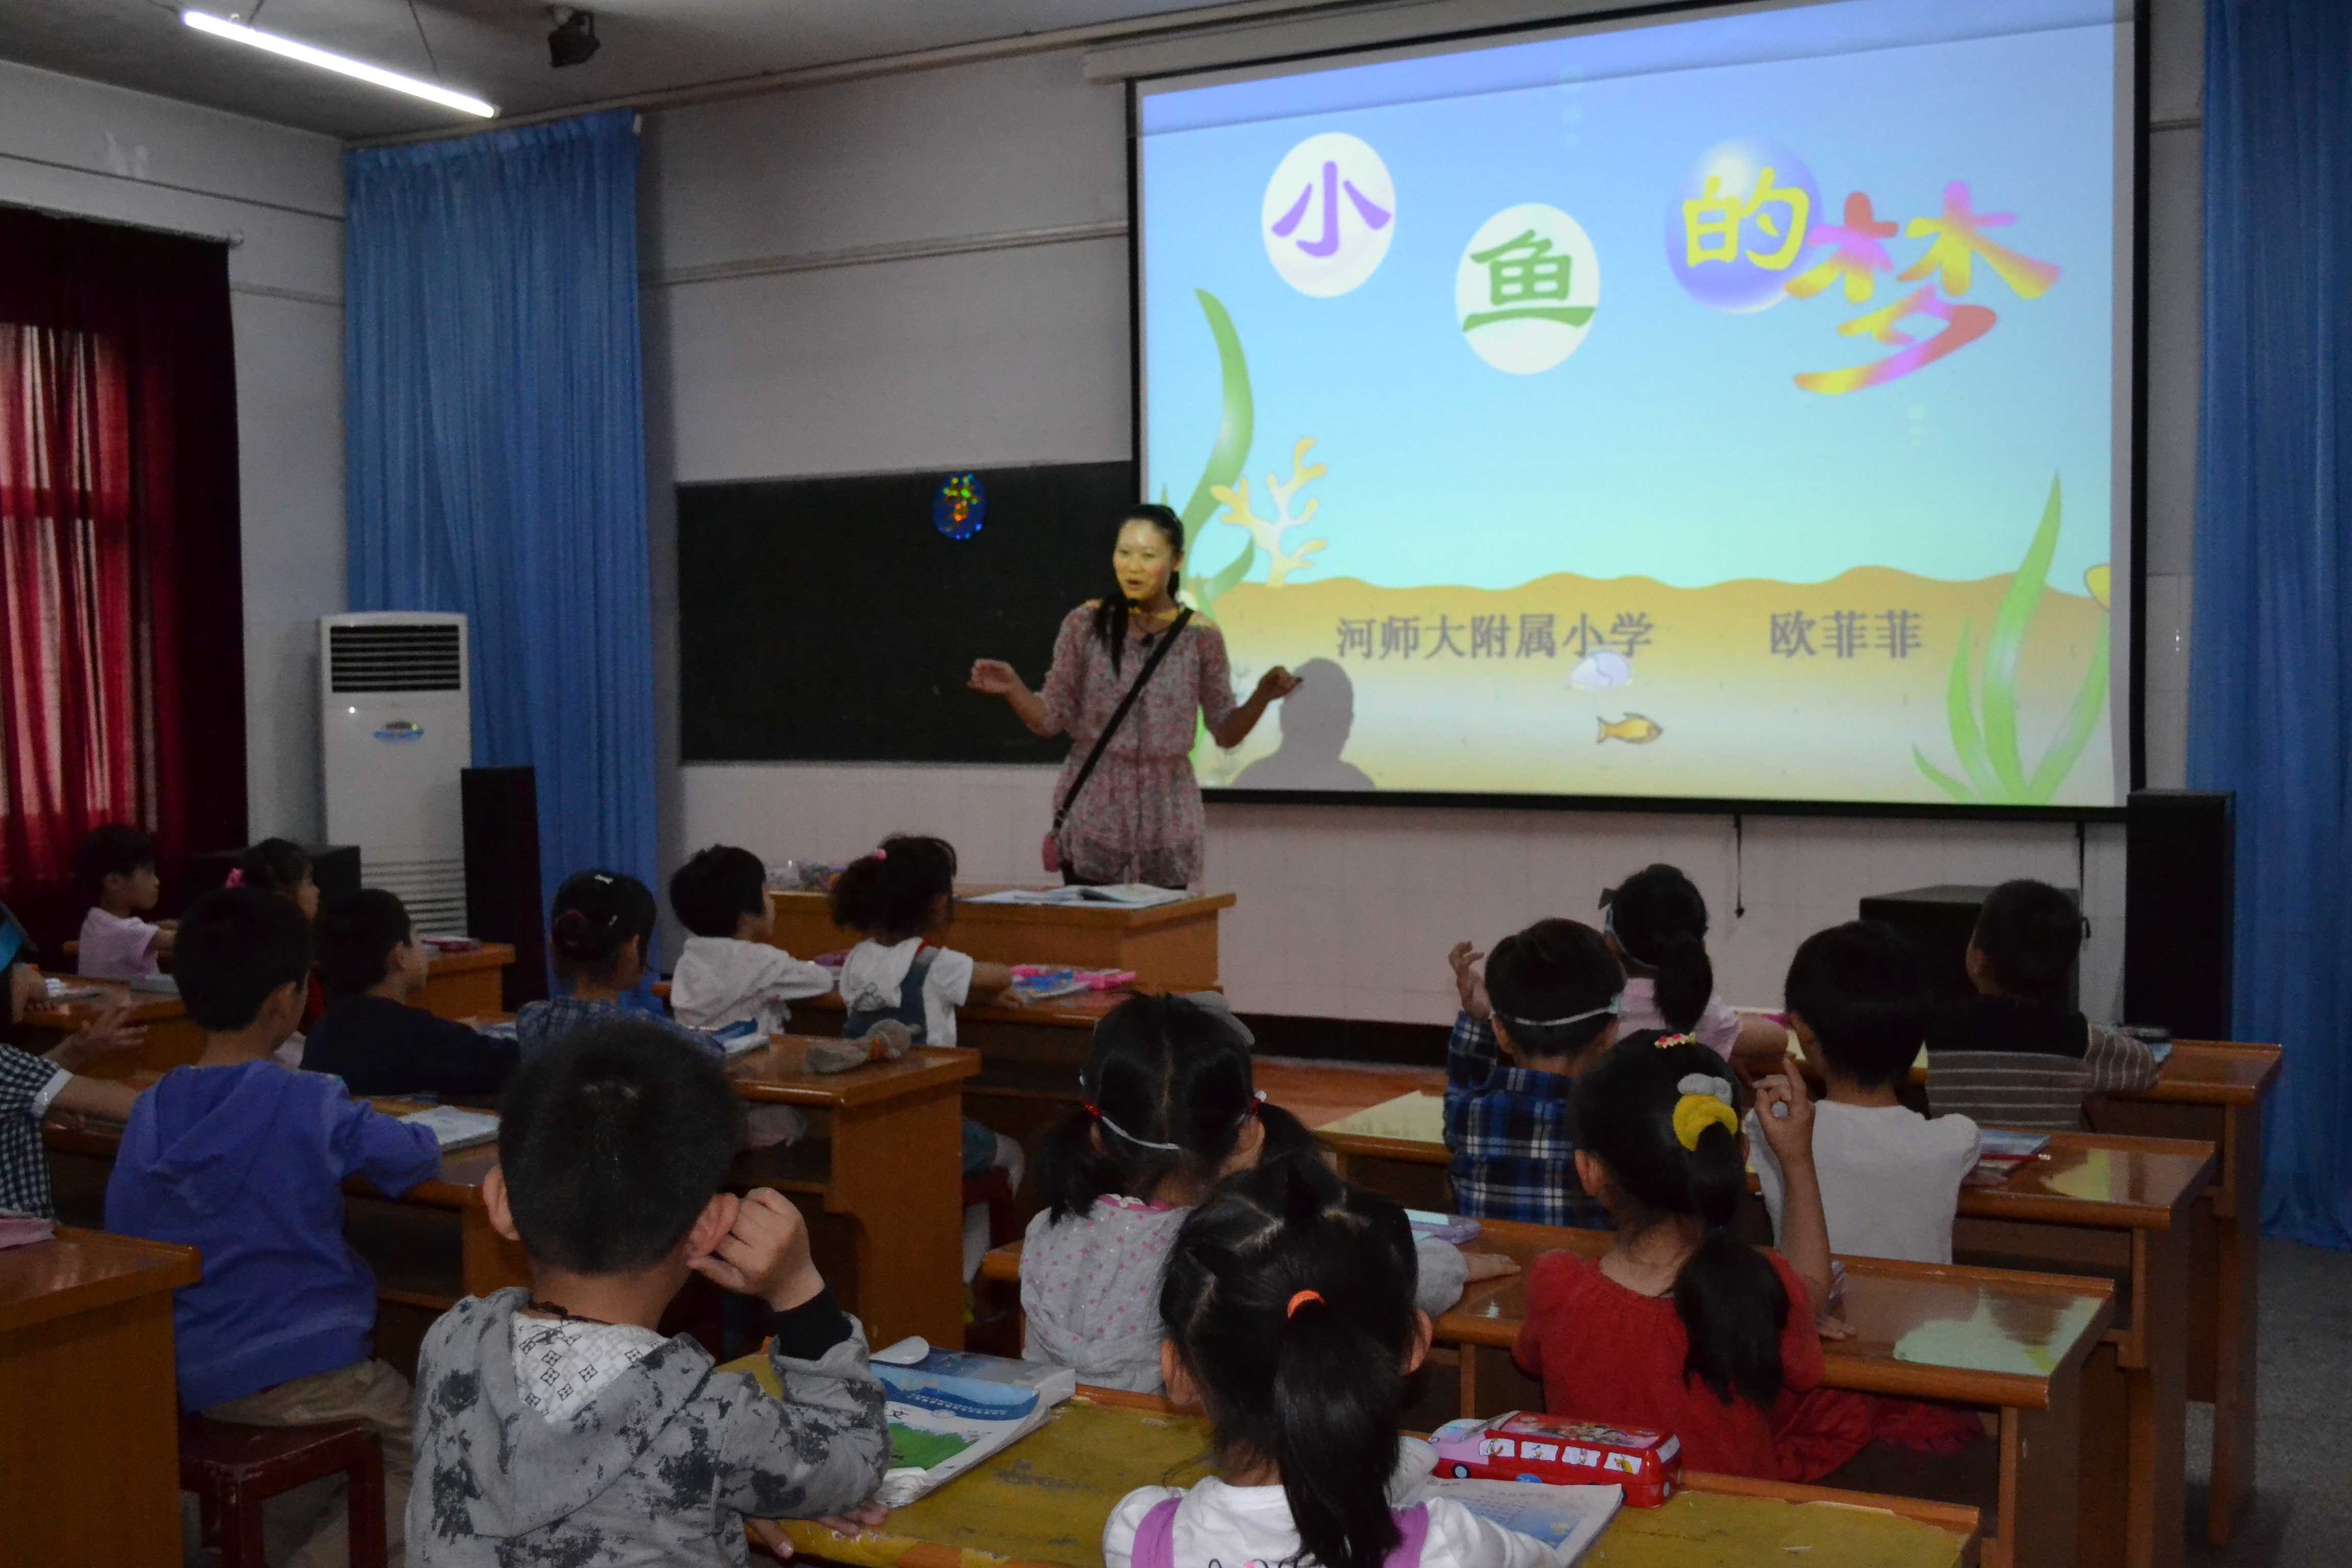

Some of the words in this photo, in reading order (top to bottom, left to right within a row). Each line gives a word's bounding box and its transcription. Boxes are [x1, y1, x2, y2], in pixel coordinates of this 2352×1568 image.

[1336, 612, 1654, 659] 河师大附属小学
[1770, 610, 1922, 657] 欧菲菲
